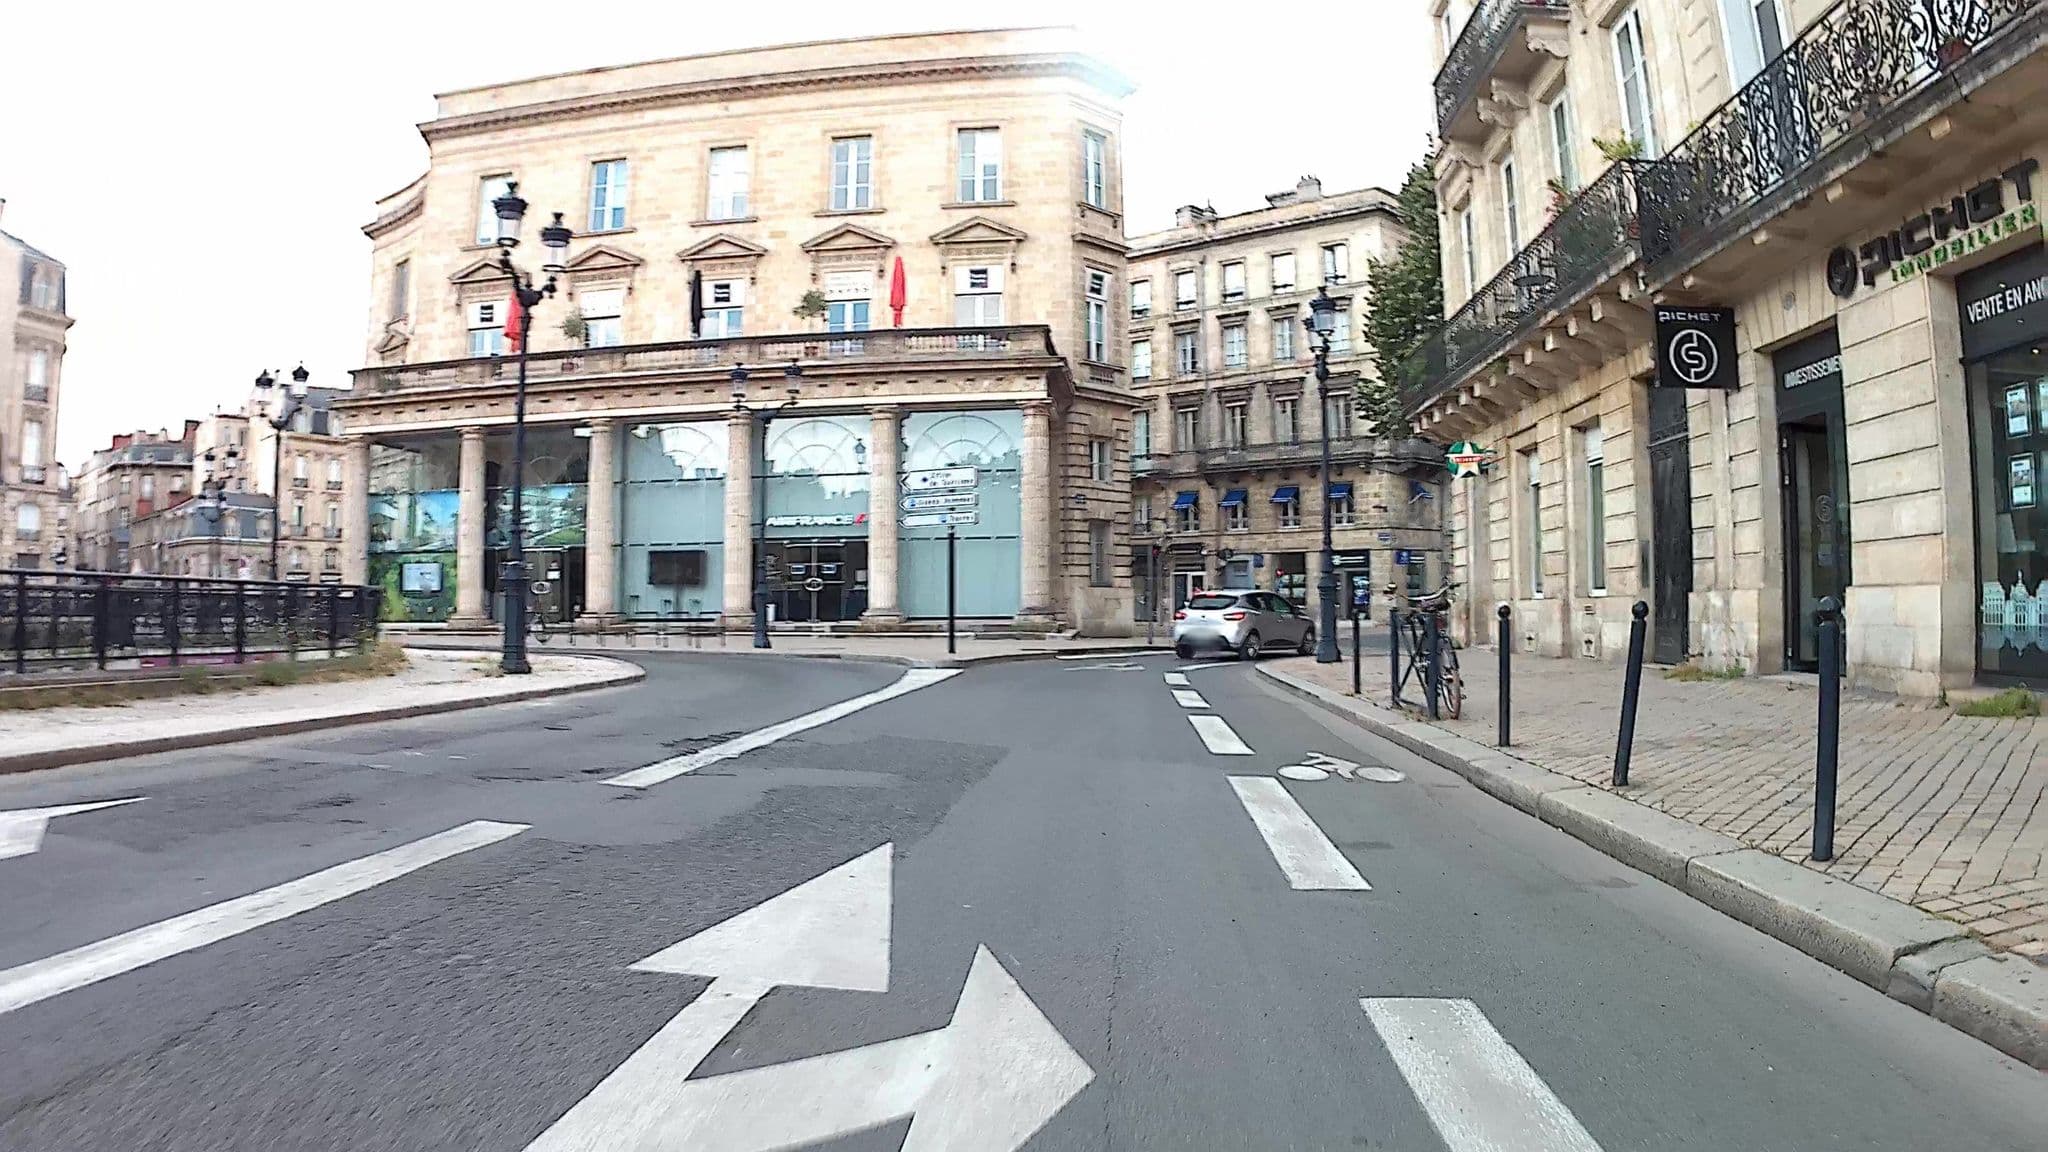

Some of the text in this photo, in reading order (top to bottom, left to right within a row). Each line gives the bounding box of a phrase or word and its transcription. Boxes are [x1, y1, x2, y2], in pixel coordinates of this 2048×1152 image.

[1859, 158, 2039, 288] PICHET
[1891, 203, 2036, 282] IMMOBILIER
[1658, 311, 1721, 323] PICHET
[1967, 293, 2004, 324] VENTE
[2005, 286, 2023, 310] EN
